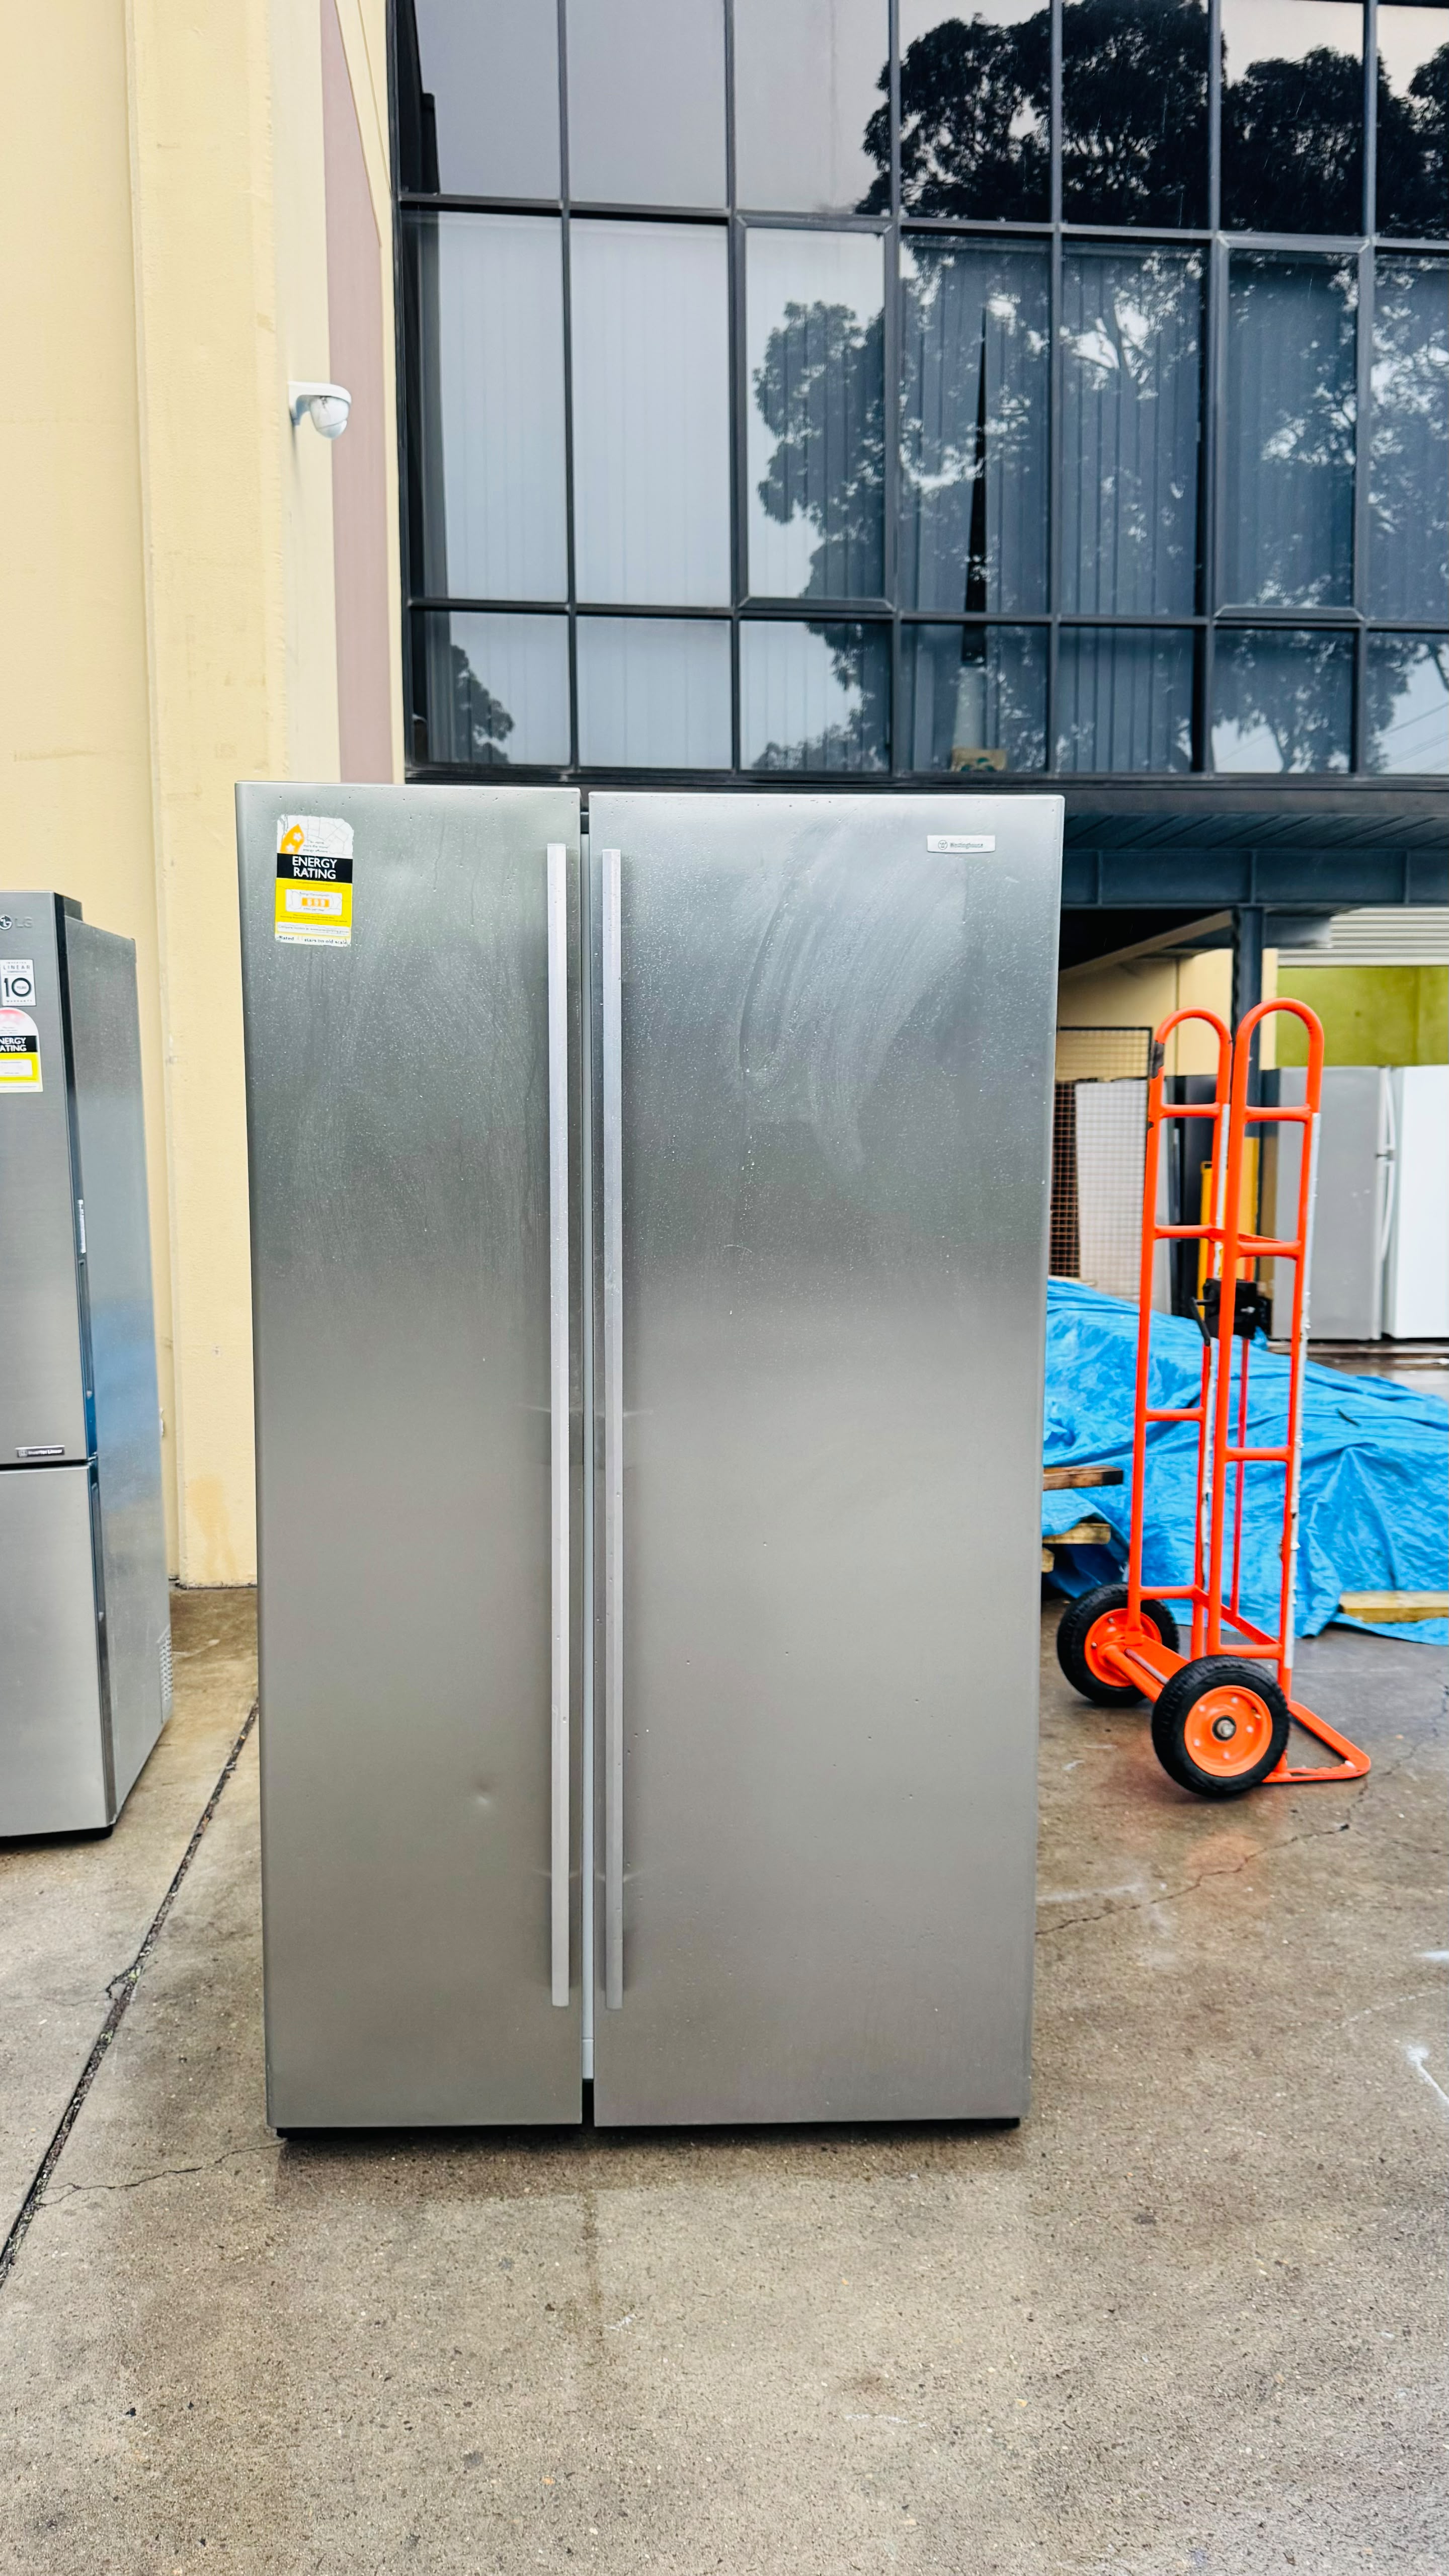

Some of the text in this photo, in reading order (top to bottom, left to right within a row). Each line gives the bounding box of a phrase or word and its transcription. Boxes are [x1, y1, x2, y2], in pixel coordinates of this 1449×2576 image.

[292, 856, 337, 868] ENERGY
[293, 866, 336, 879] RATING
[15, 917, 33, 928] LG
[4, 978, 32, 997] 10
